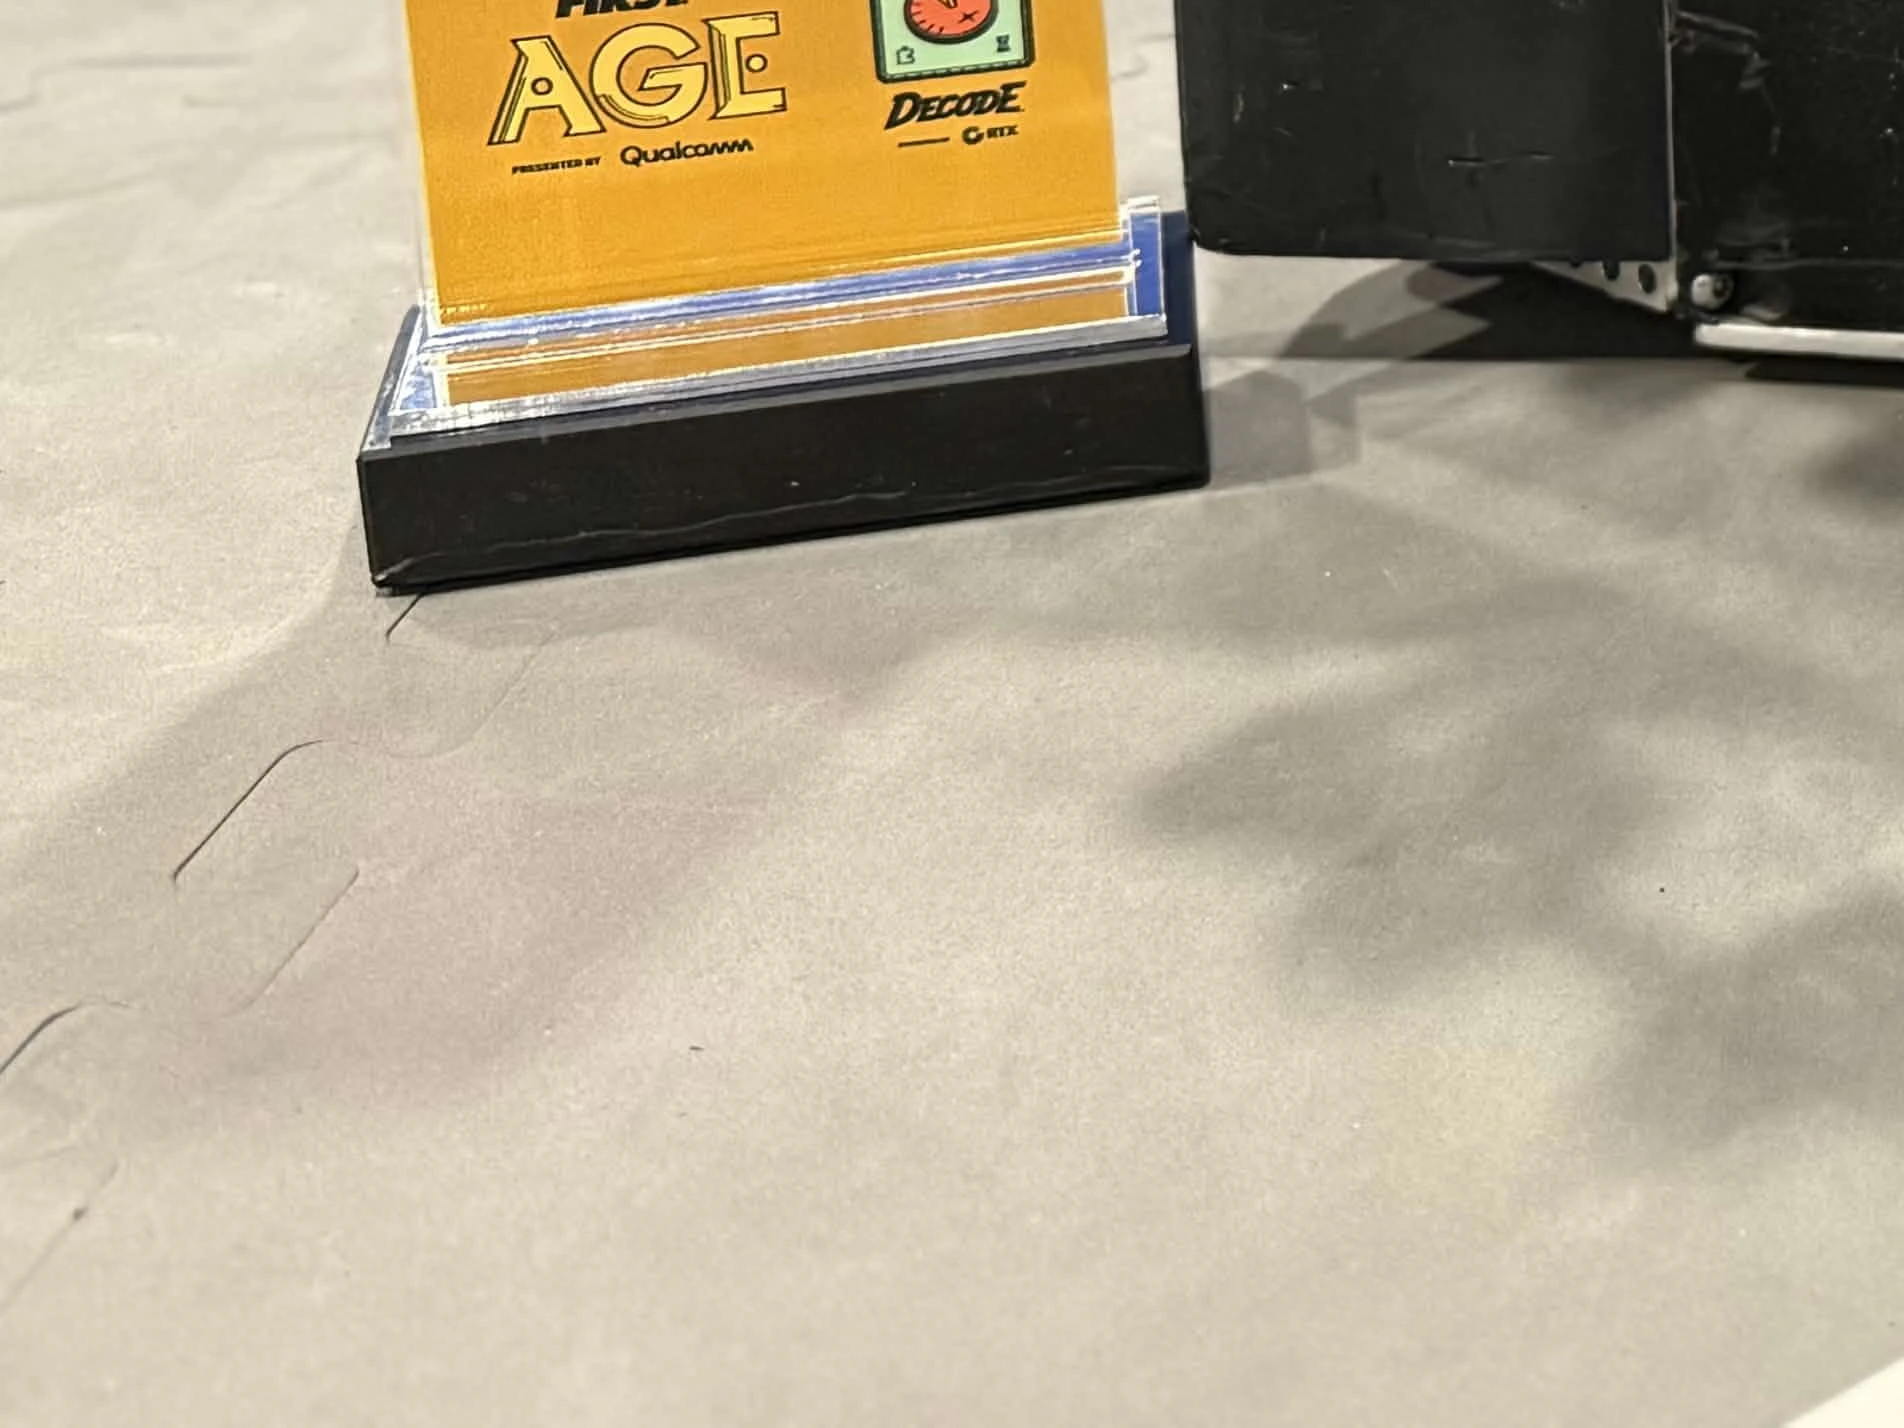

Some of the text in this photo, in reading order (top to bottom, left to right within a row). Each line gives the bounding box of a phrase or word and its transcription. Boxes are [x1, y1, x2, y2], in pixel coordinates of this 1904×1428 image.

[487, 10, 788, 146] AGE
[883, 80, 1028, 130] DECODE
[620, 138, 755, 168] Qualcomm
